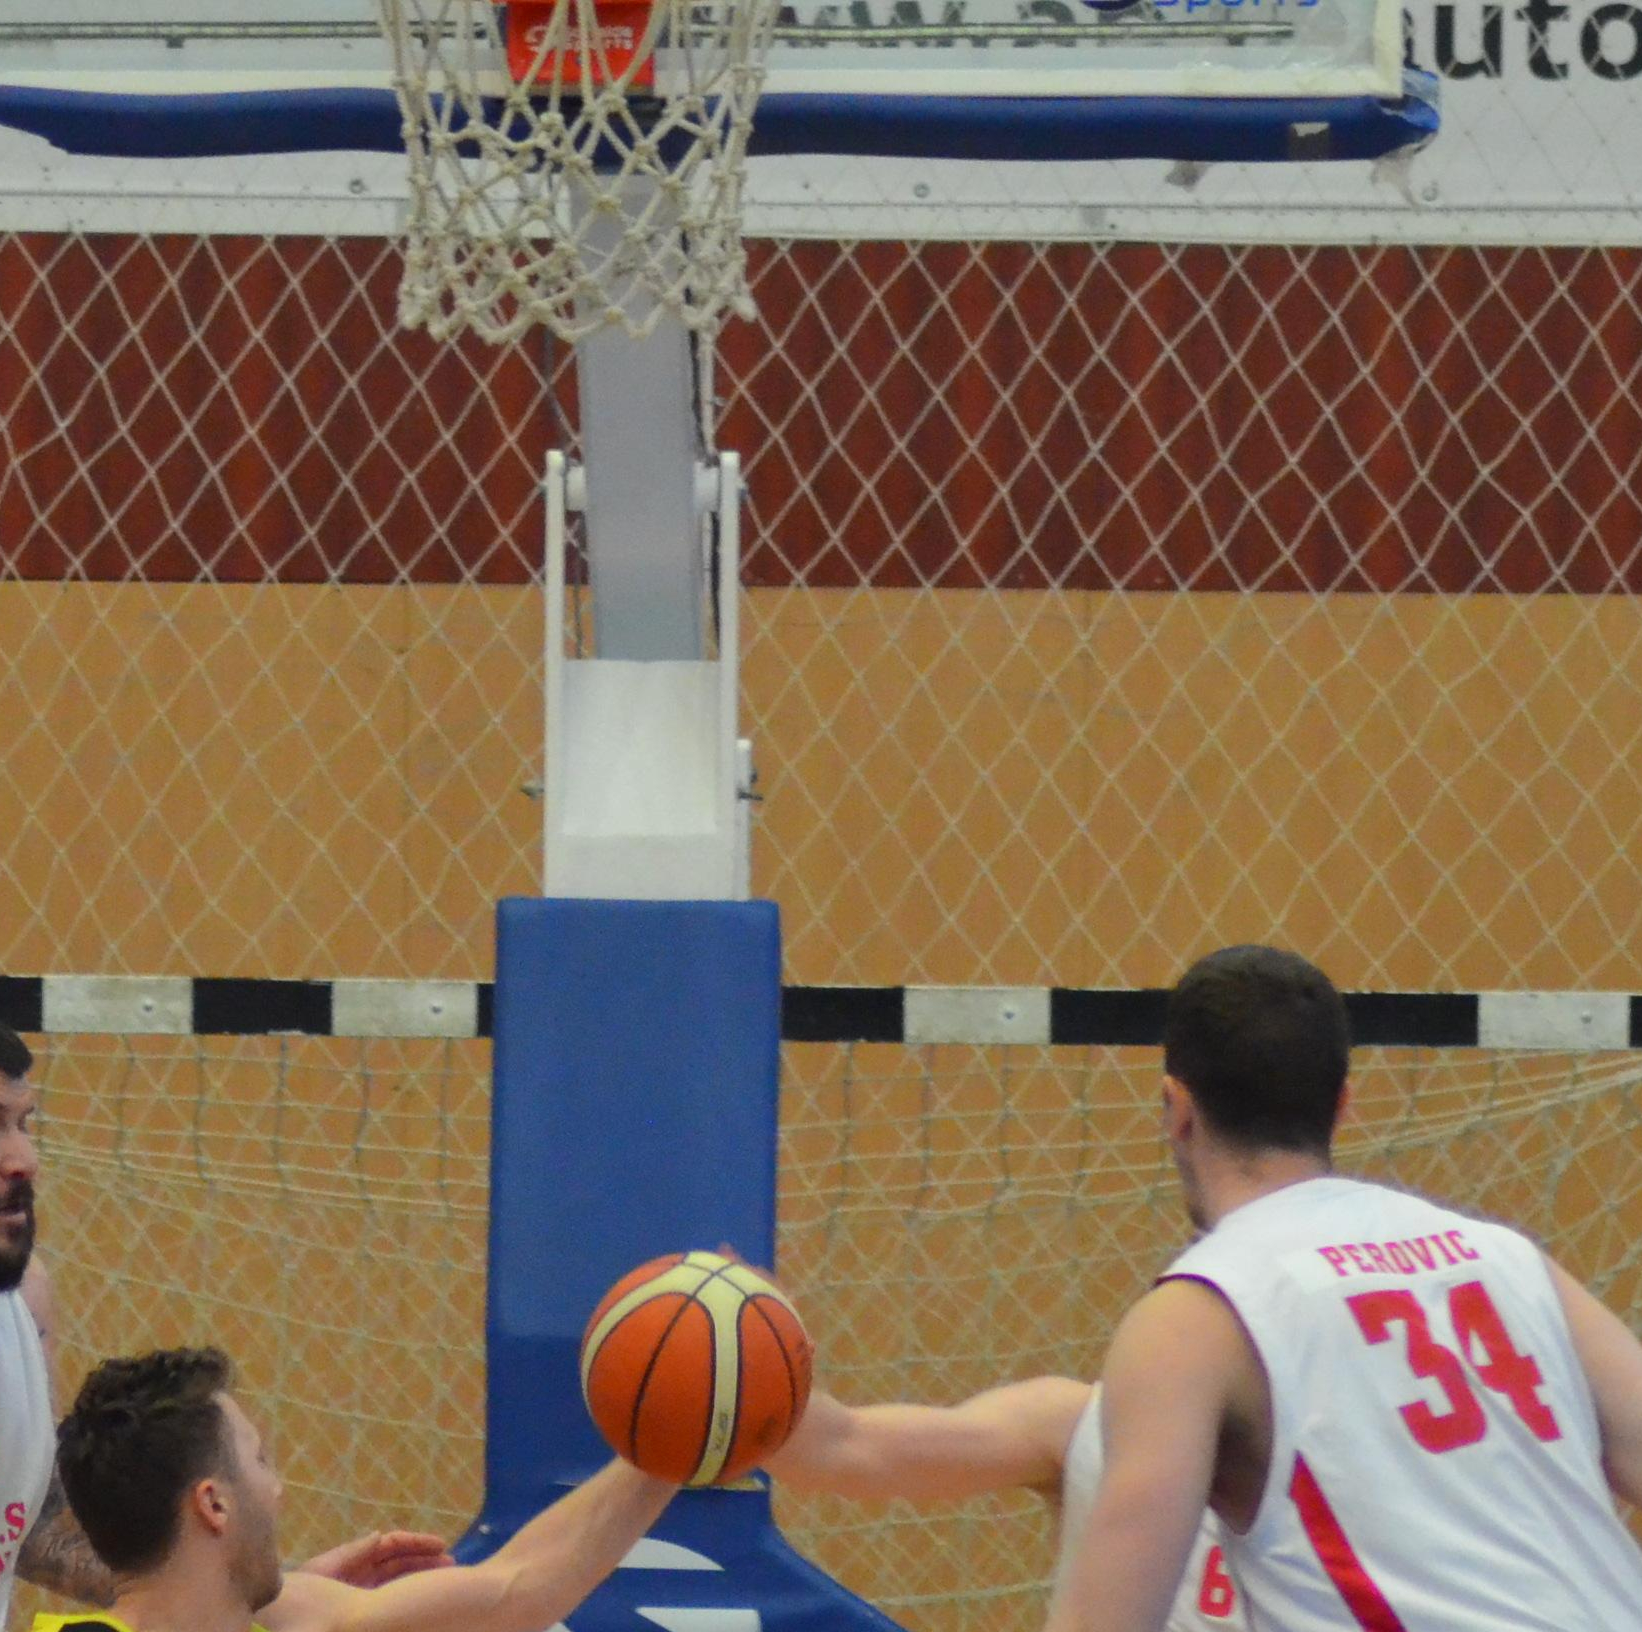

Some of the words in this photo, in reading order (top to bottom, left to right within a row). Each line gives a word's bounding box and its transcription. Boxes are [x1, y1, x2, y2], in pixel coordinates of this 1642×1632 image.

[1316, 1230, 1480, 1277] PEROVIC
[1344, 1281, 1563, 1455] 34
[1198, 1545, 1235, 1618] 6
